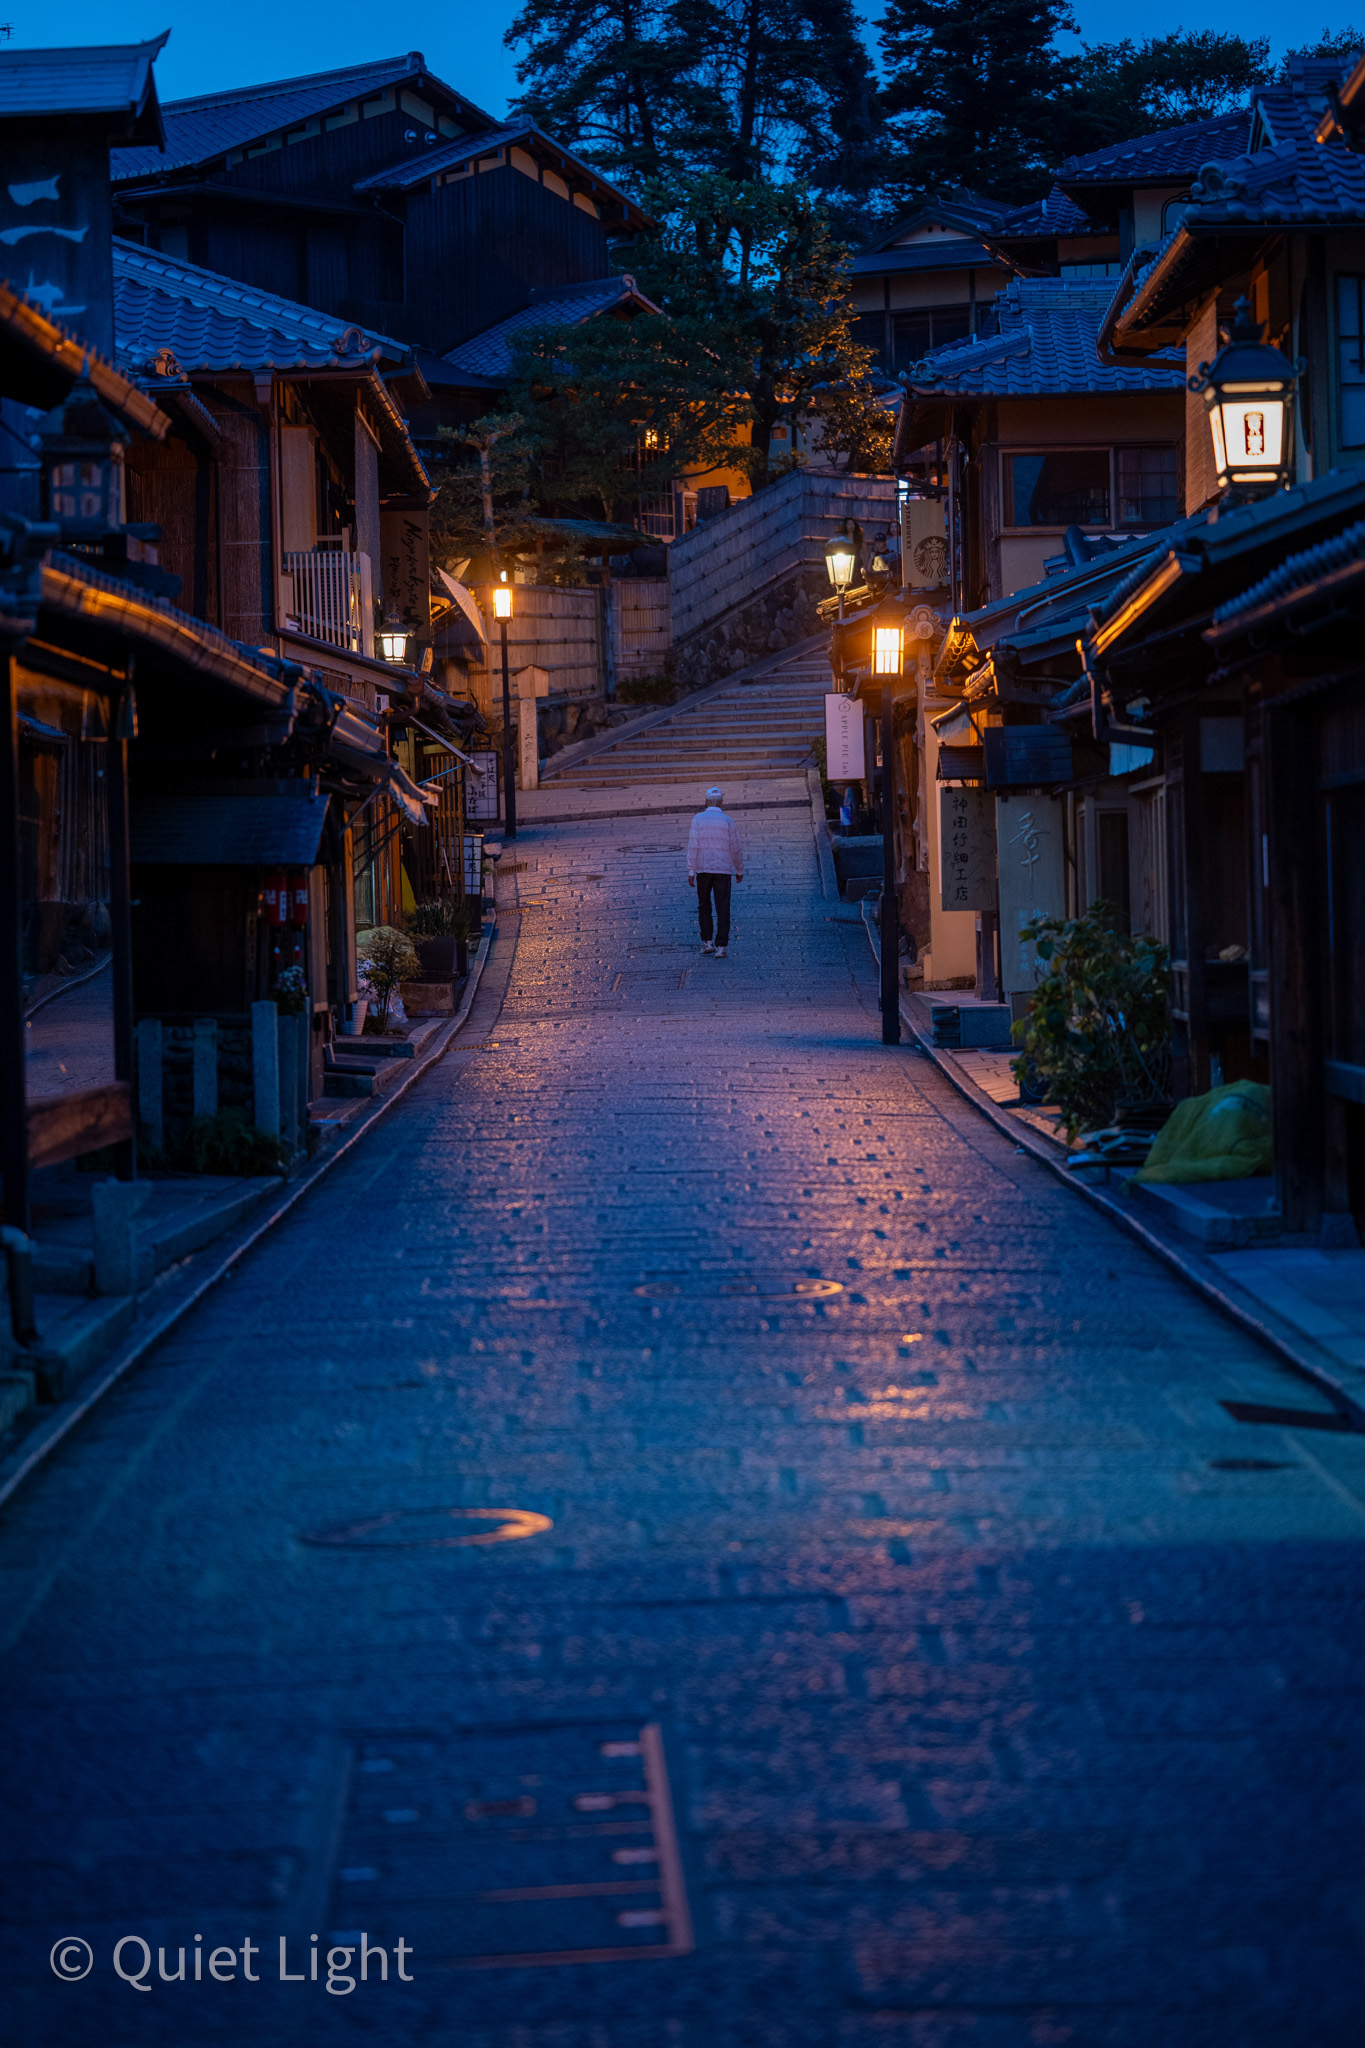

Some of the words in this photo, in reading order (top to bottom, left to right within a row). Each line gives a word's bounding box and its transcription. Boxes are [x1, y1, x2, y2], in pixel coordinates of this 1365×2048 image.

[401, 519, 423, 556] Ninja
[905, 505, 913, 550] STARBUCKS
[403, 575, 425, 605] Kyoto
[841, 714, 849, 740] APPLE
[841, 744, 849, 758] PIE
[841, 761, 849, 775] lab
[467, 785, 479, 813] ふたば
[952, 796, 969, 901] 神田竹細工店
